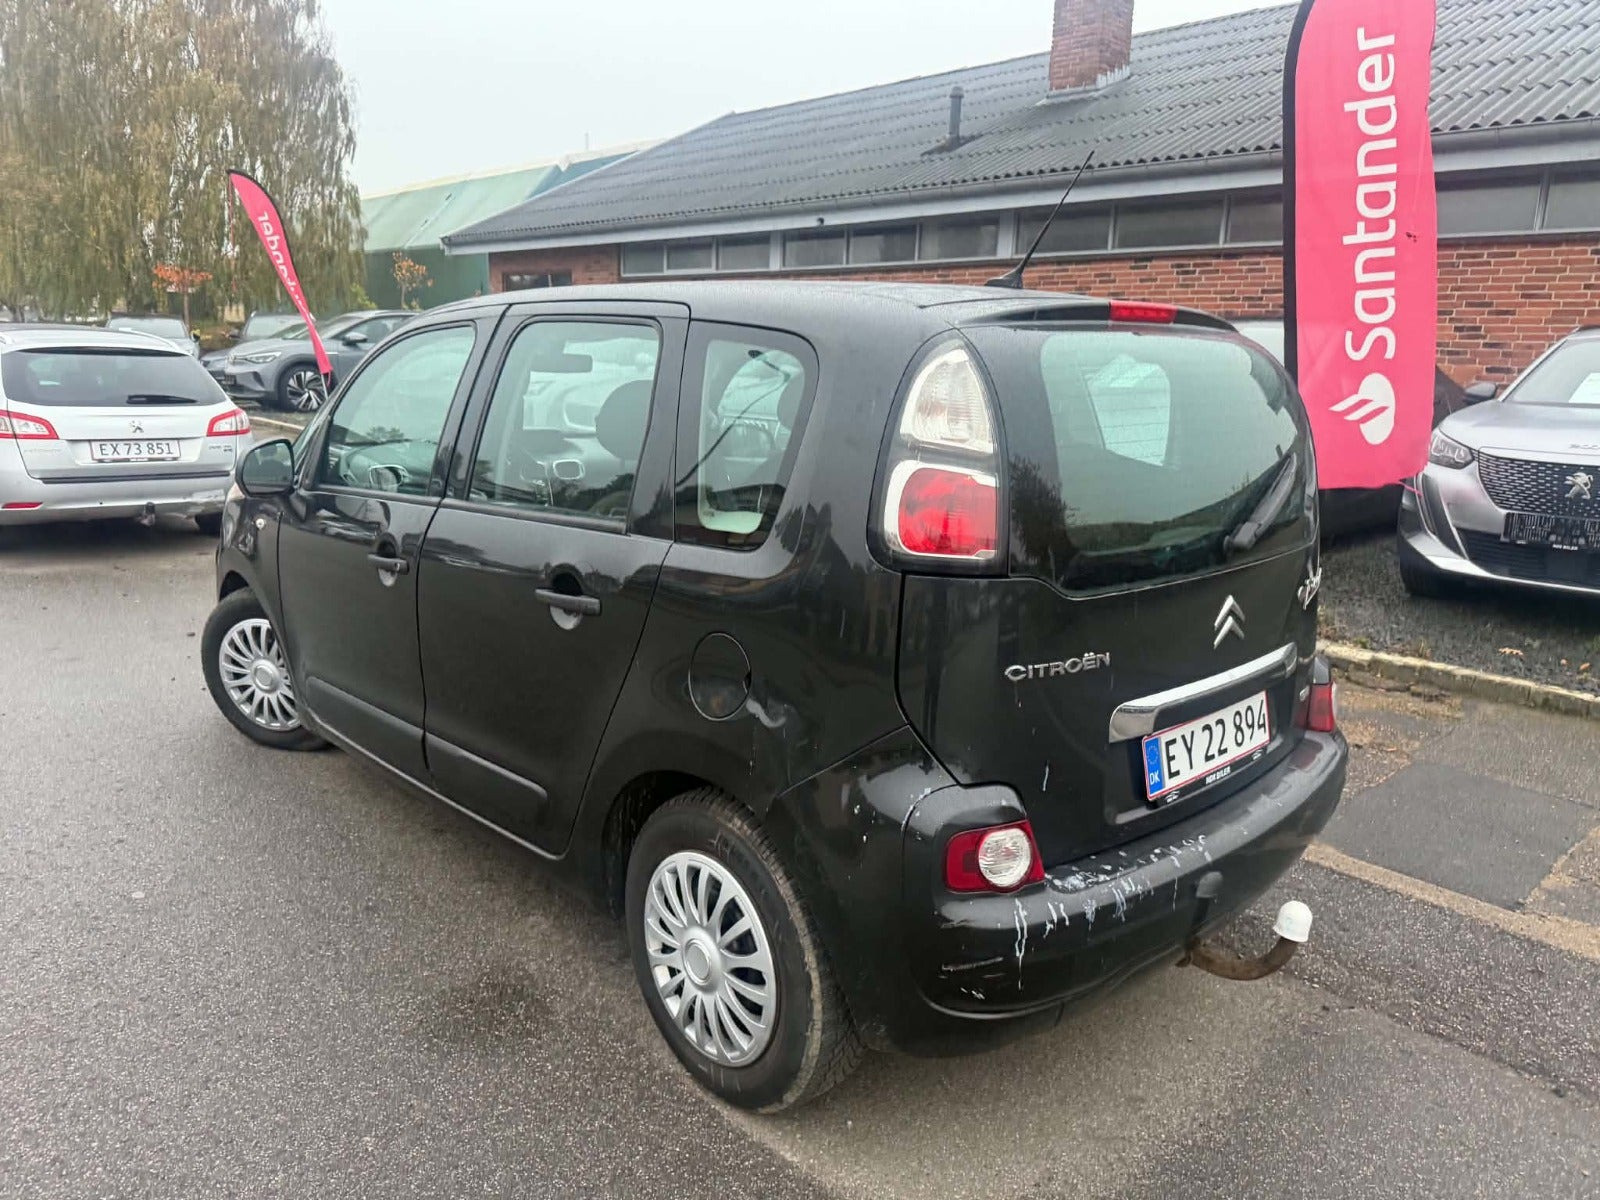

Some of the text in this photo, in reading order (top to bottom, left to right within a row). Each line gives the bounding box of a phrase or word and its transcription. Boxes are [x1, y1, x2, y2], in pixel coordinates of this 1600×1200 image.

[1343, 26, 1398, 360] Santander
[99, 442, 174, 456] EX 73 851
[1004, 651, 1111, 681] CITROËN
[1165, 699, 1267, 779] EY 22 894
[1149, 771, 1160, 785] DK
